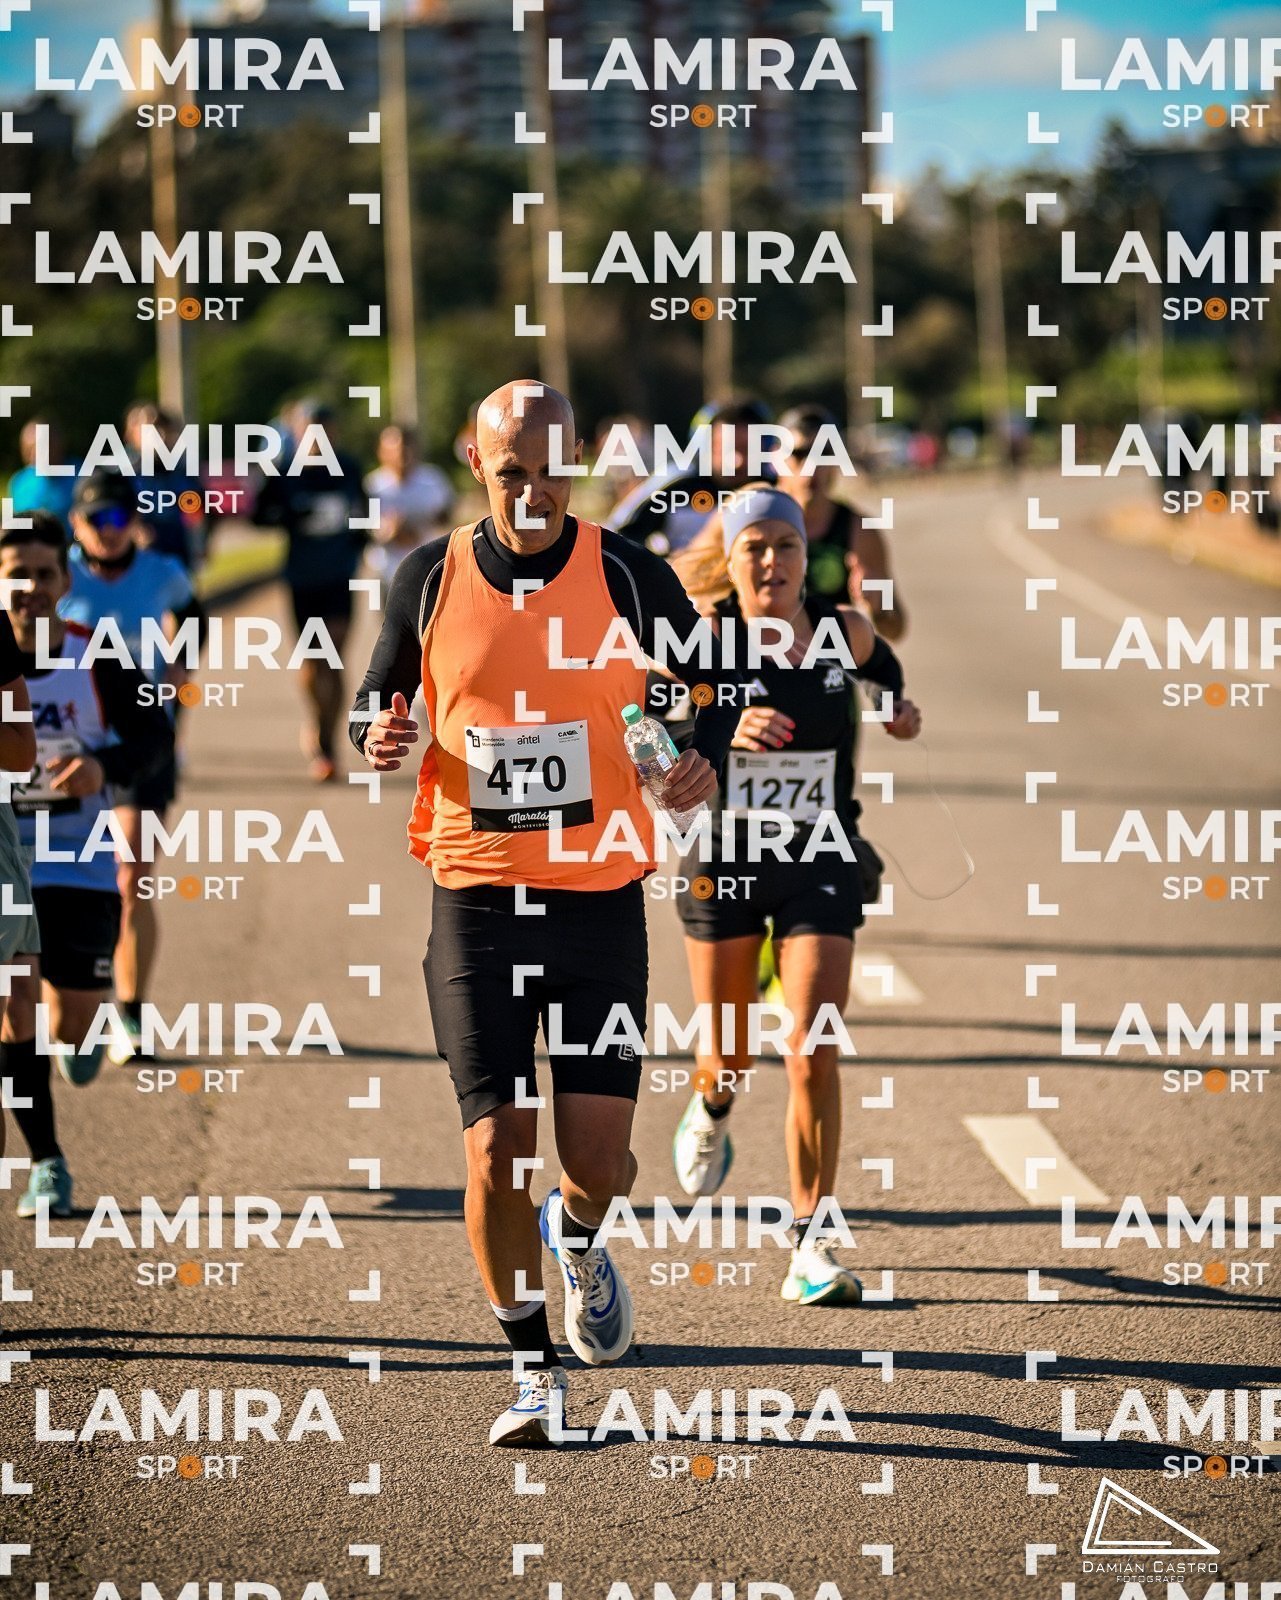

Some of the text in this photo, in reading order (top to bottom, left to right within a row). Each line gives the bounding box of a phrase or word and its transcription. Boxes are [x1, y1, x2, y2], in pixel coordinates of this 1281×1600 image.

[517, 735, 541, 745] antel
[487, 755, 567, 796] 470
[738, 777, 826, 810] 1274
[508, 811, 554, 824] Maratón
